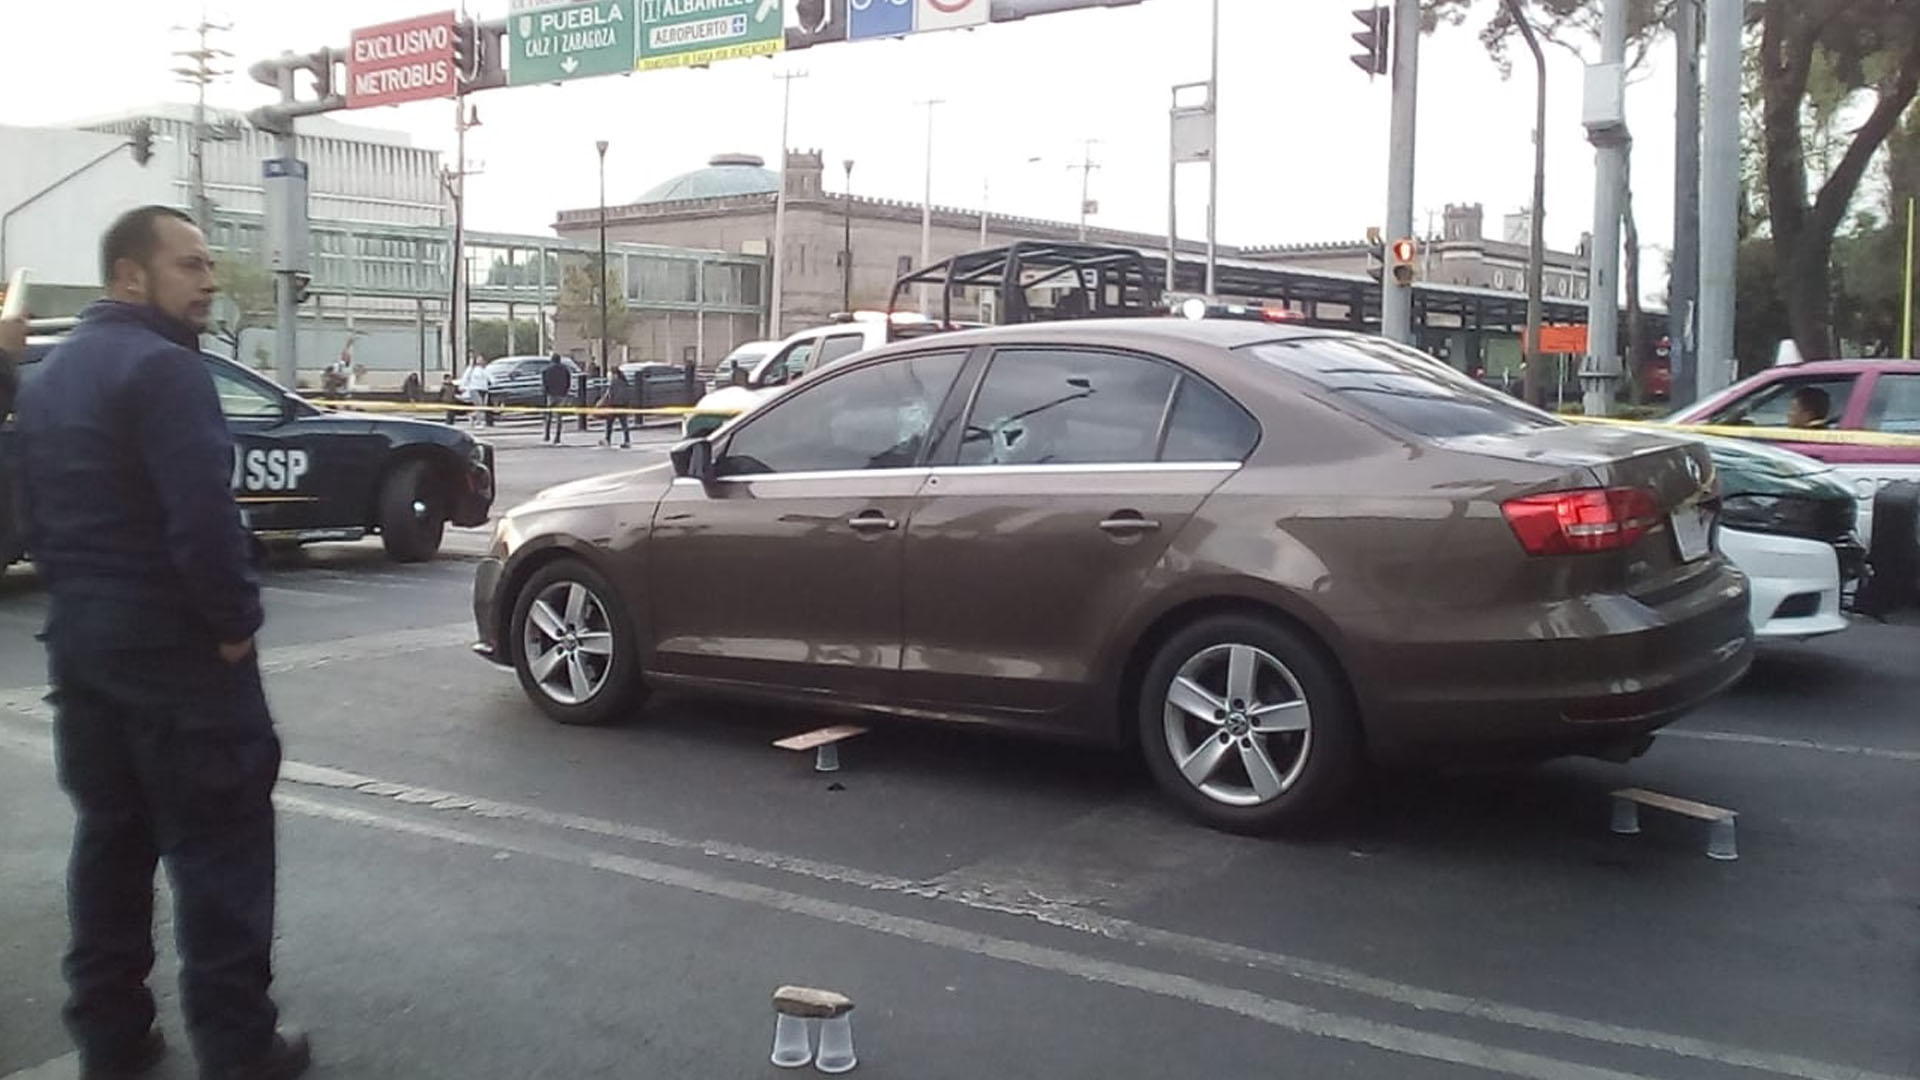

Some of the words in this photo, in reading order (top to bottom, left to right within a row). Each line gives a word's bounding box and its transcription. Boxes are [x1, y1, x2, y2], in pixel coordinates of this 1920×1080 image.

[541, 3, 623, 32] PUEBLA
[654, 20, 728, 45] AEROPUERTO
[355, 25, 448, 61] EXCLUSIVO
[561, 27, 617, 53] ZARAGOZA
[355, 59, 448, 95] METROBUS
[246, 449, 308, 490] SSP
